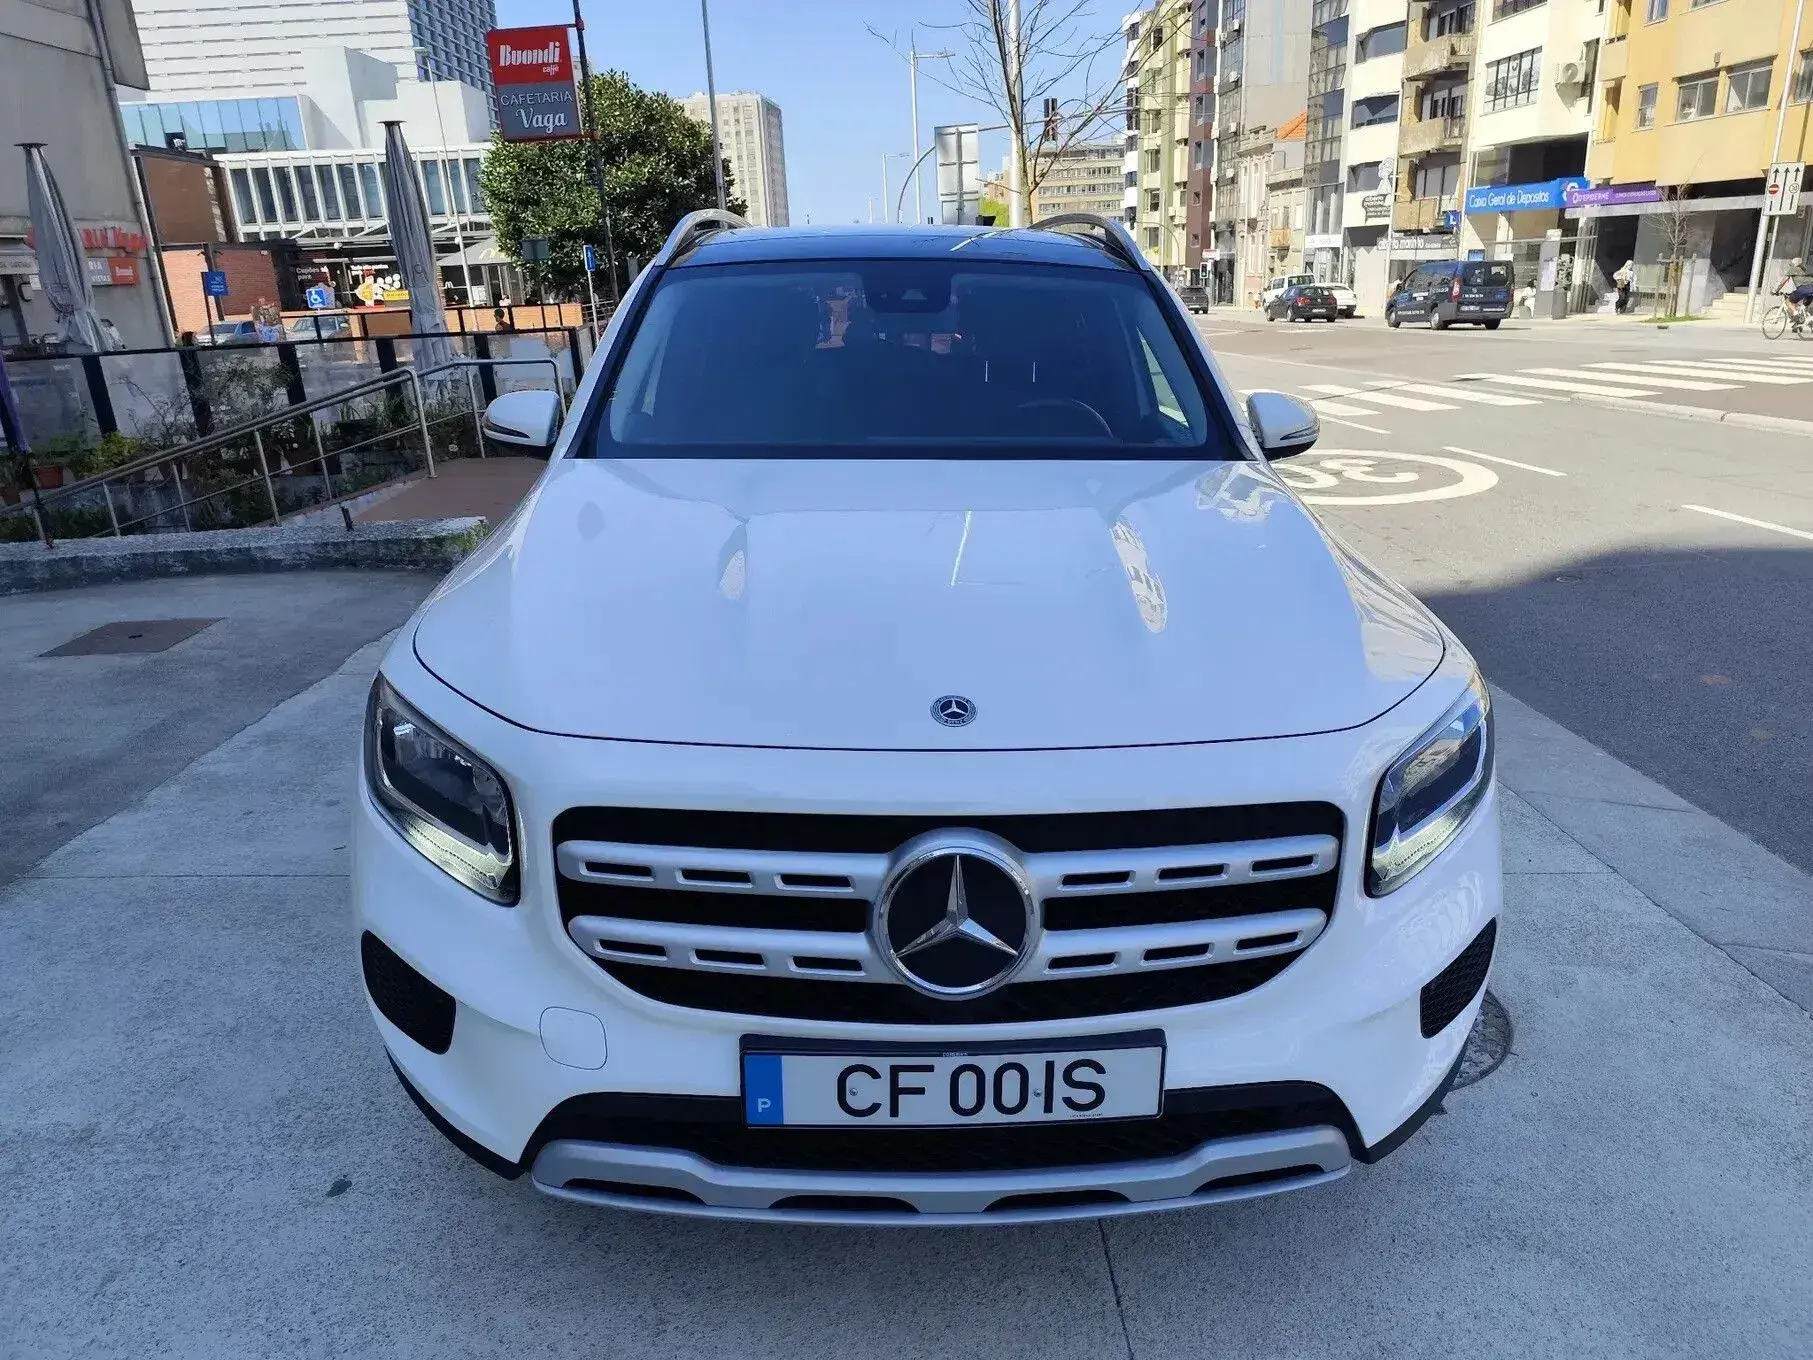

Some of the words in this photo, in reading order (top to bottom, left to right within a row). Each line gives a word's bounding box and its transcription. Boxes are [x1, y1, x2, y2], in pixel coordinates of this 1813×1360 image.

[499, 41, 561, 67] Buondi
[500, 90, 573, 106] CAFETARIA
[515, 107, 568, 134] Vaga
[1488, 191, 1506, 206] Geral
[1507, 191, 1516, 204] de
[837, 1064, 935, 1118] CF
[949, 1061, 1029, 1117] 00
[1043, 1058, 1107, 1114] IS
[757, 1098, 771, 1113] P
